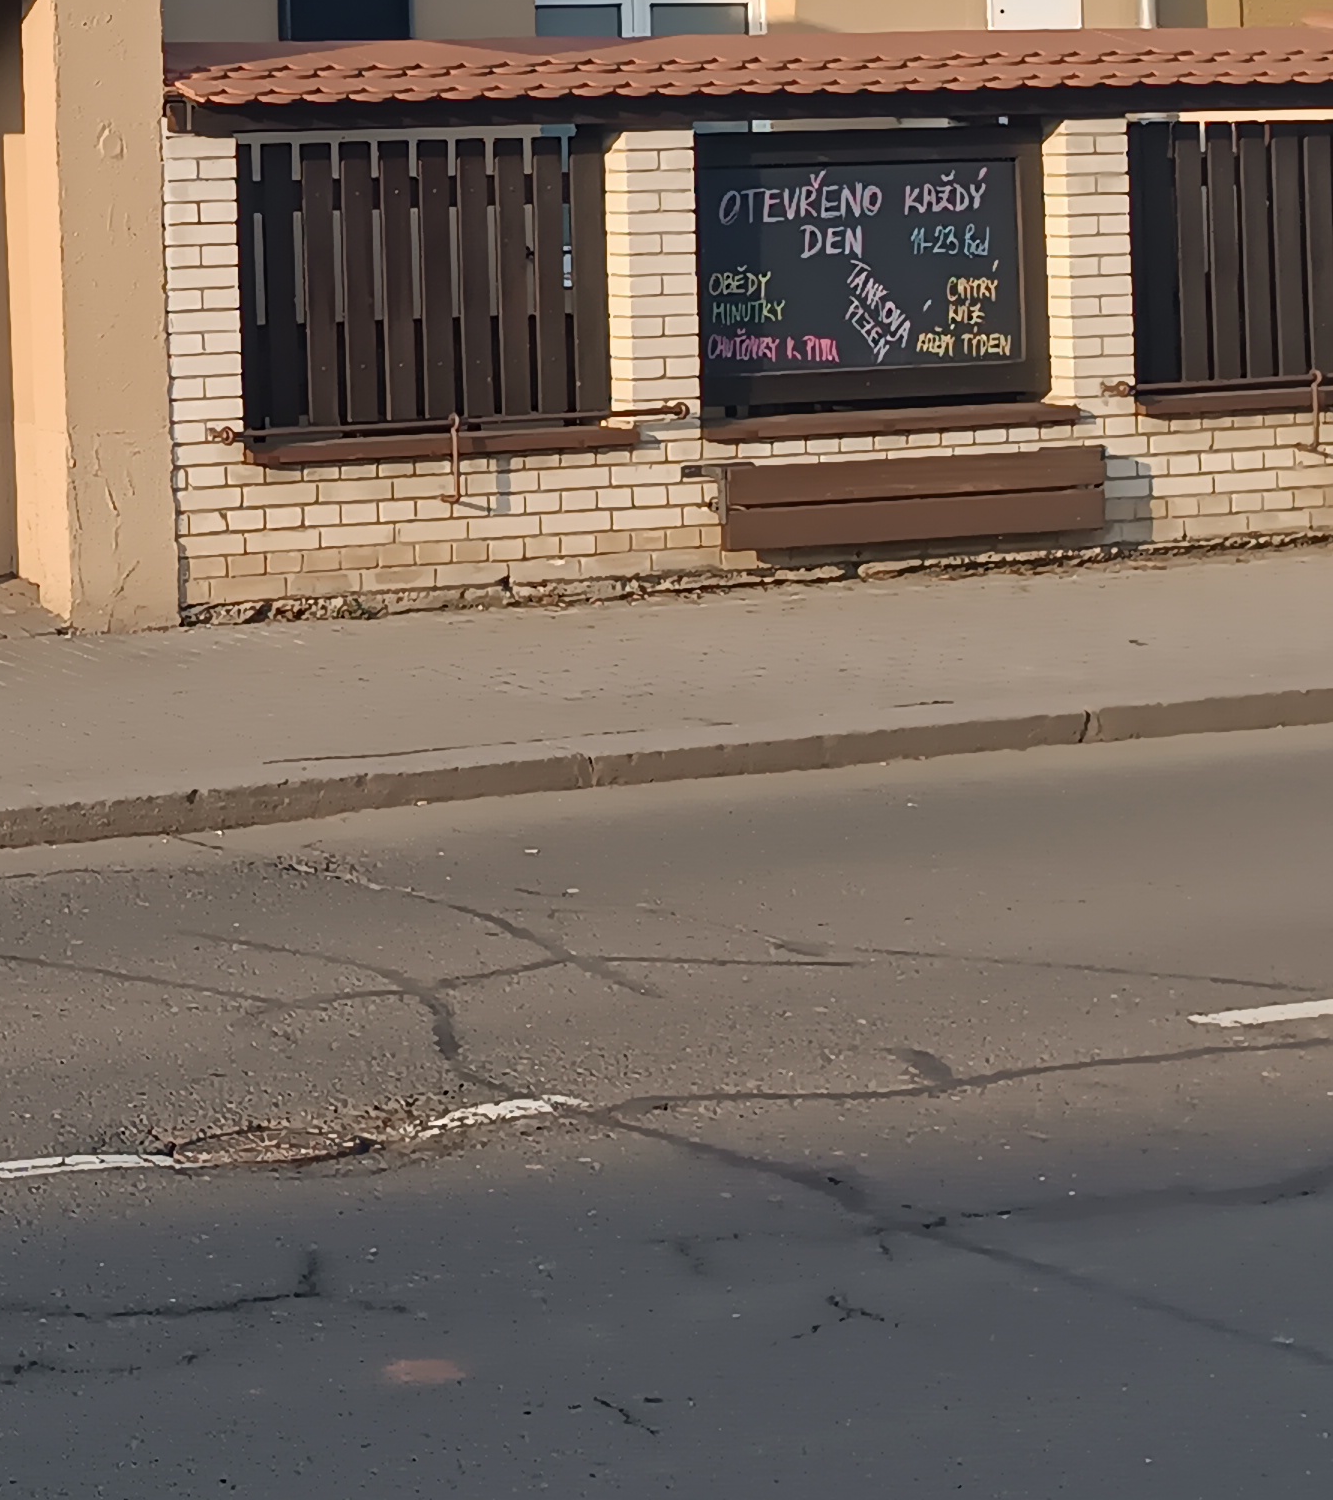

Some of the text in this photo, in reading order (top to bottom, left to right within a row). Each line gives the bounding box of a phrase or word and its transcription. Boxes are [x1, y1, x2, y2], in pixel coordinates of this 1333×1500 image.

[719, 167, 987, 225] OTEVŘENO KAŽDÝ
[799, 224, 863, 258] DEN
[708, 264, 771, 299] OBĚDY
[712, 300, 786, 326] MINUTKY
